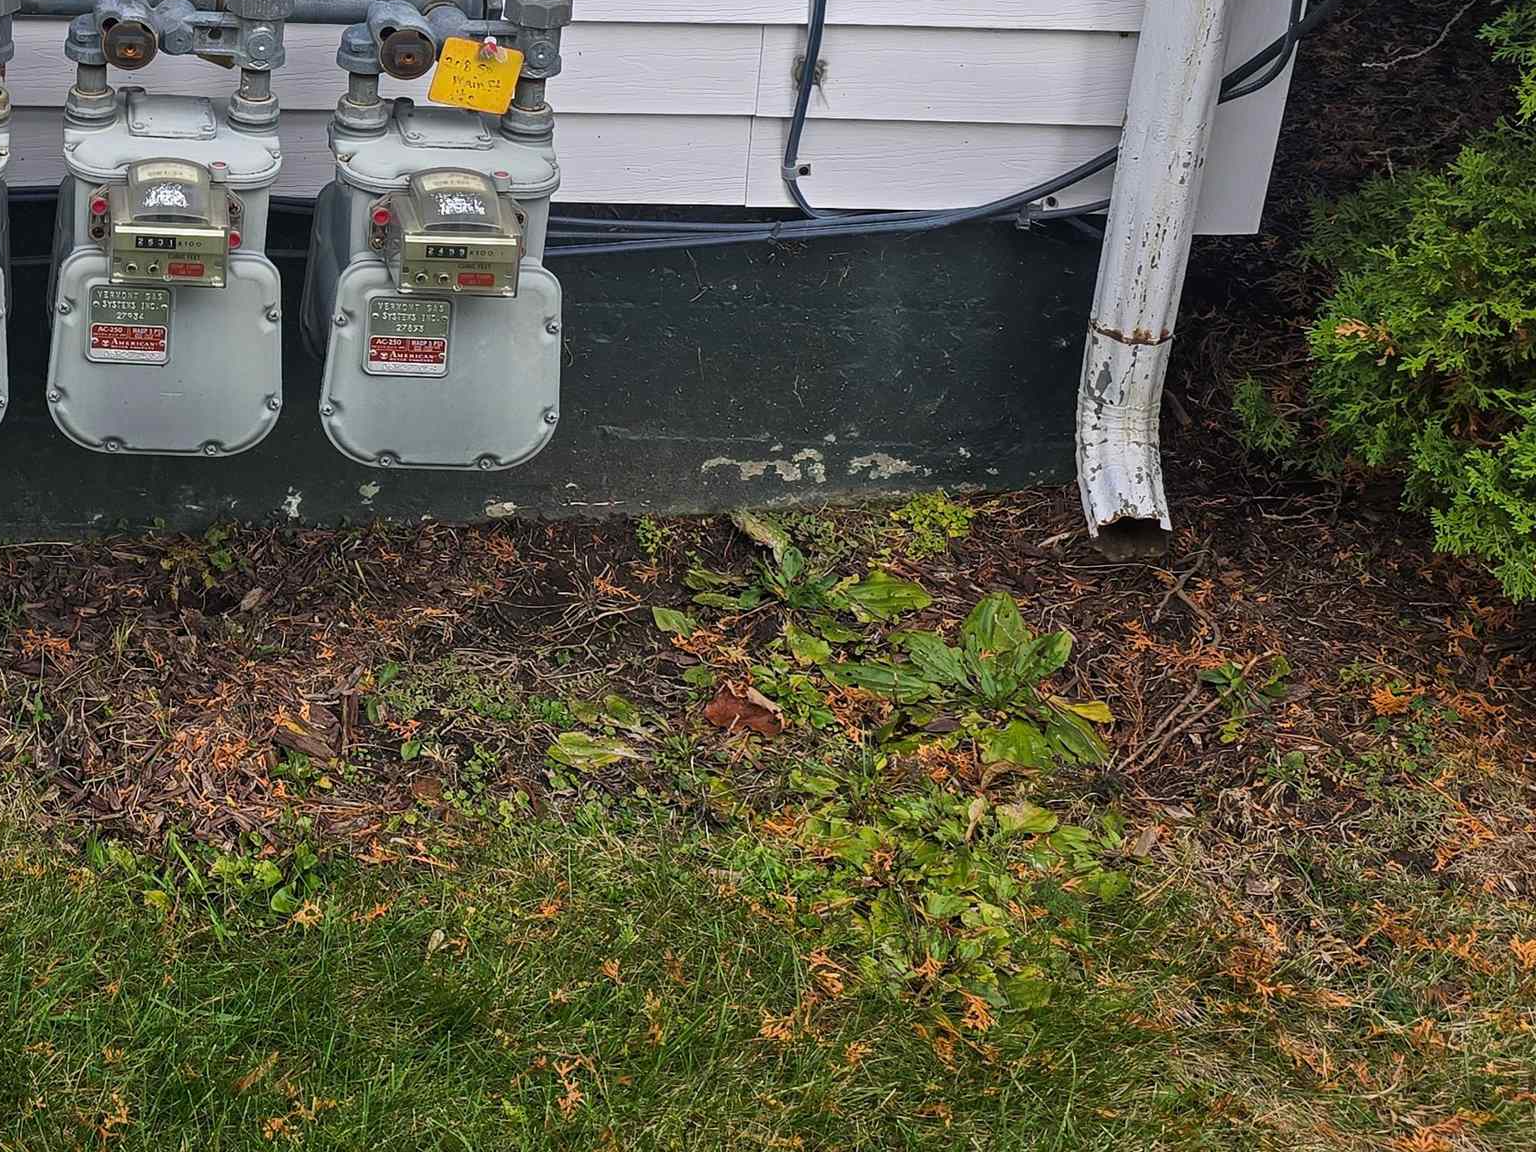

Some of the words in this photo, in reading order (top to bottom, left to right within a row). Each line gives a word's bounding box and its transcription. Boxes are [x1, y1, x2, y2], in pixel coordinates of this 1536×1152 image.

[98, 291, 139, 299] VERMONT
[102, 300, 136, 309] SYSTEMS
[378, 302, 420, 311] VERMONT
[427, 304, 444, 312] GAS
[383, 312, 416, 321] SYSTEMS
